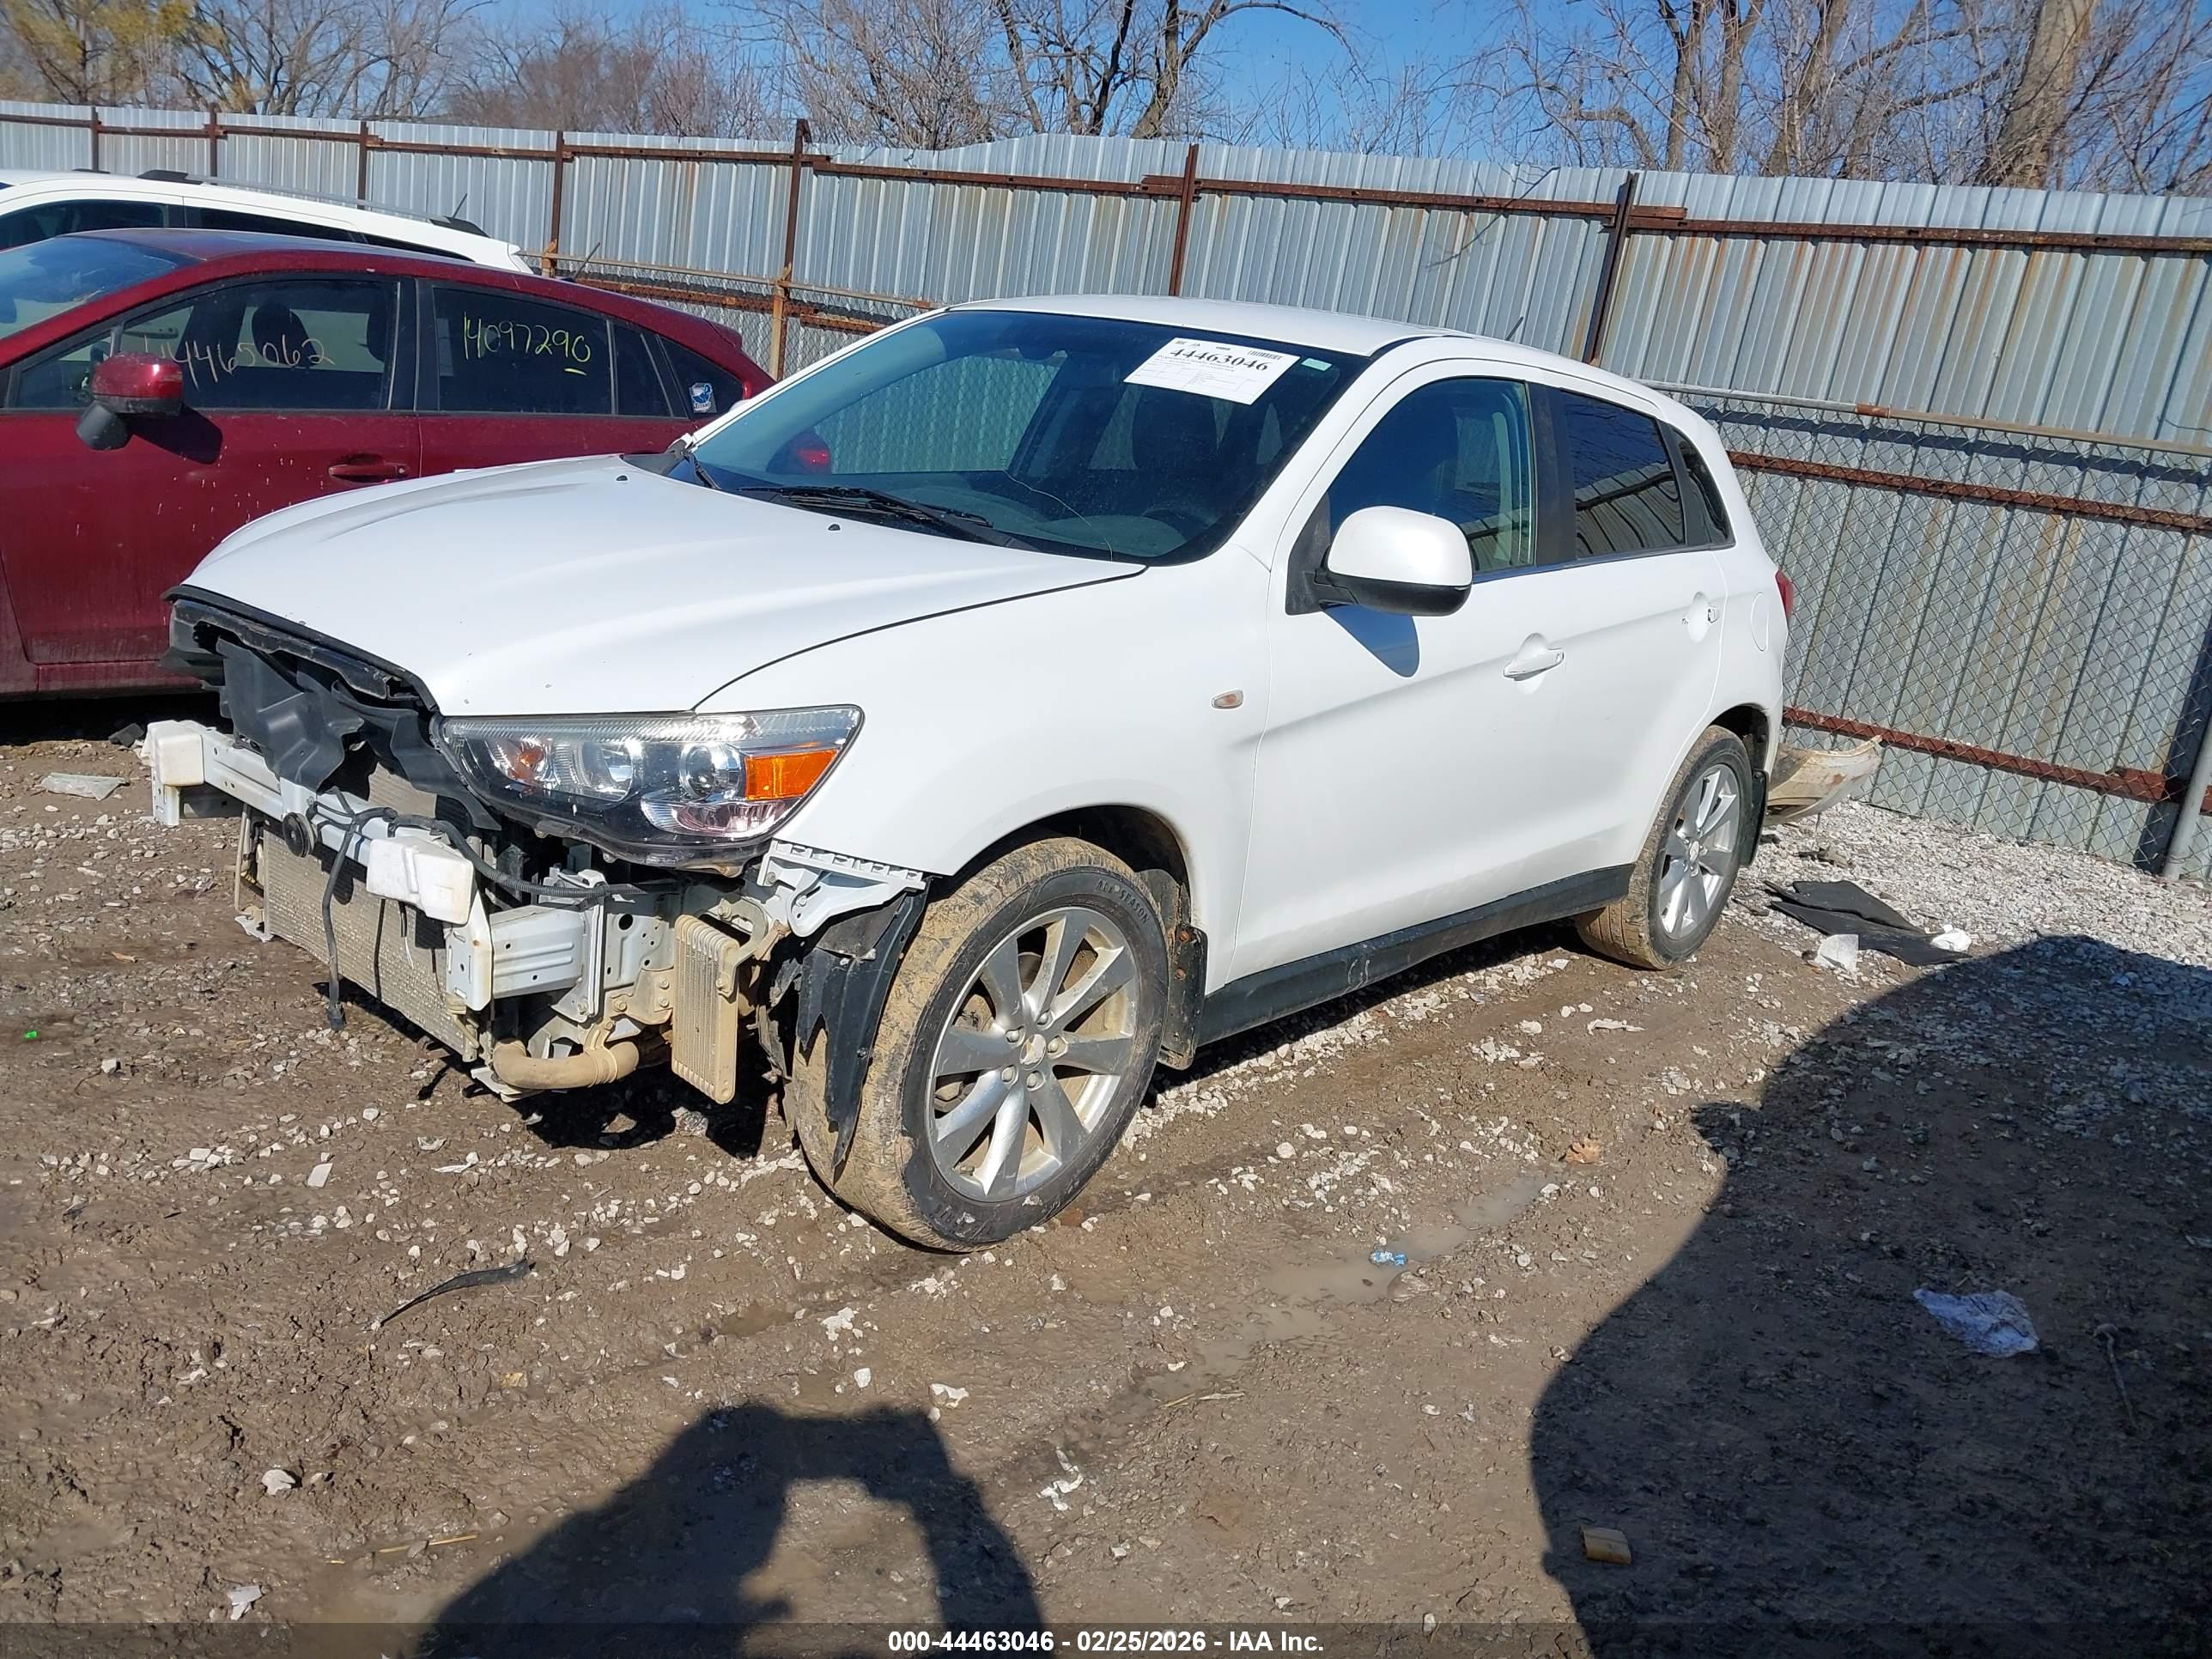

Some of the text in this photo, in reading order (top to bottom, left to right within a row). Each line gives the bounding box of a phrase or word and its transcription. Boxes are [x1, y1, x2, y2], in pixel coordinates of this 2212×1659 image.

[464, 311, 591, 362] 14097290
[1170, 348, 1269, 371] 44463046
[1120, 890, 1150, 924] SEASON
